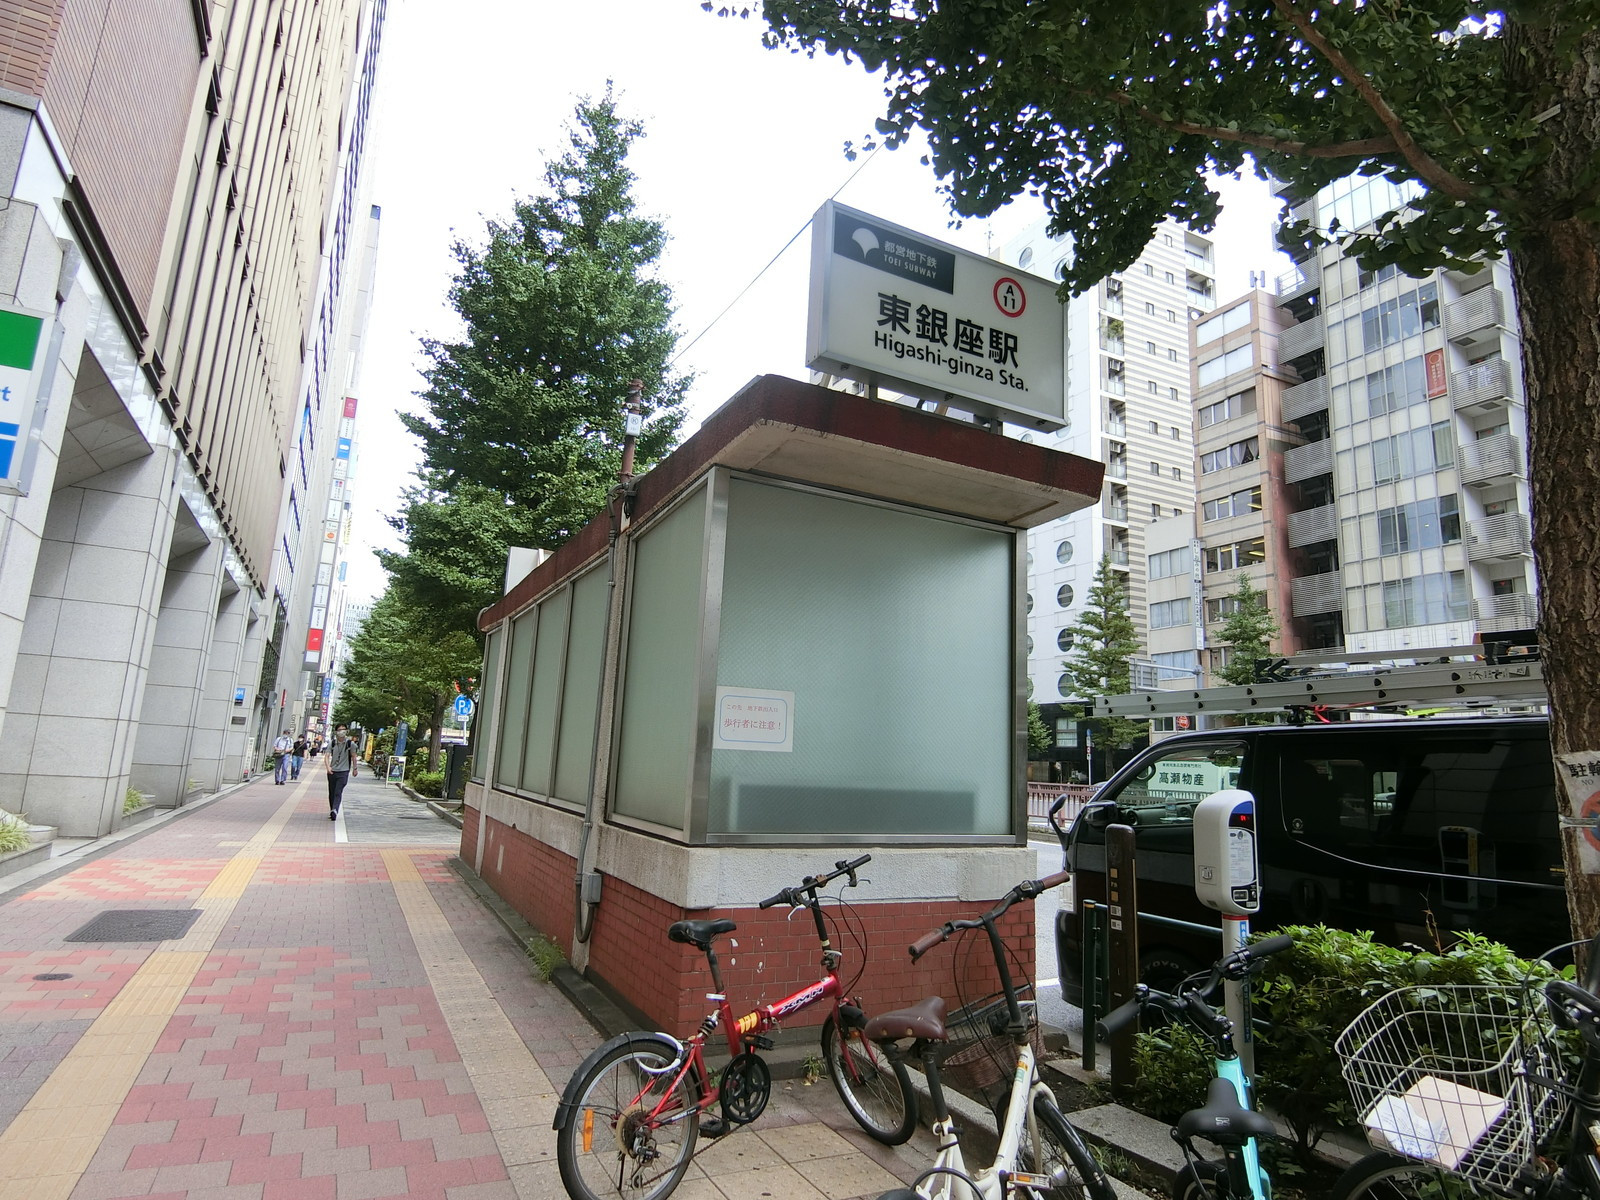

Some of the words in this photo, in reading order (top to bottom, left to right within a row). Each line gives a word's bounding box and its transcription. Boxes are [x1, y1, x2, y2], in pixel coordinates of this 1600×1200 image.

[883, 254, 902, 268] TOEI
[904, 260, 937, 279] SUBWAY
[884, 240, 937, 269] 都営地下鉄
[1005, 284, 1015, 296] A
[1002, 296, 1016, 310] 11
[876, 292, 1019, 369] 東銀座駅
[875, 331, 993, 382] Higashi-ginza
[999, 369, 1029, 392] Sta.
[1158, 771, 1204, 786] 高瀬物産
